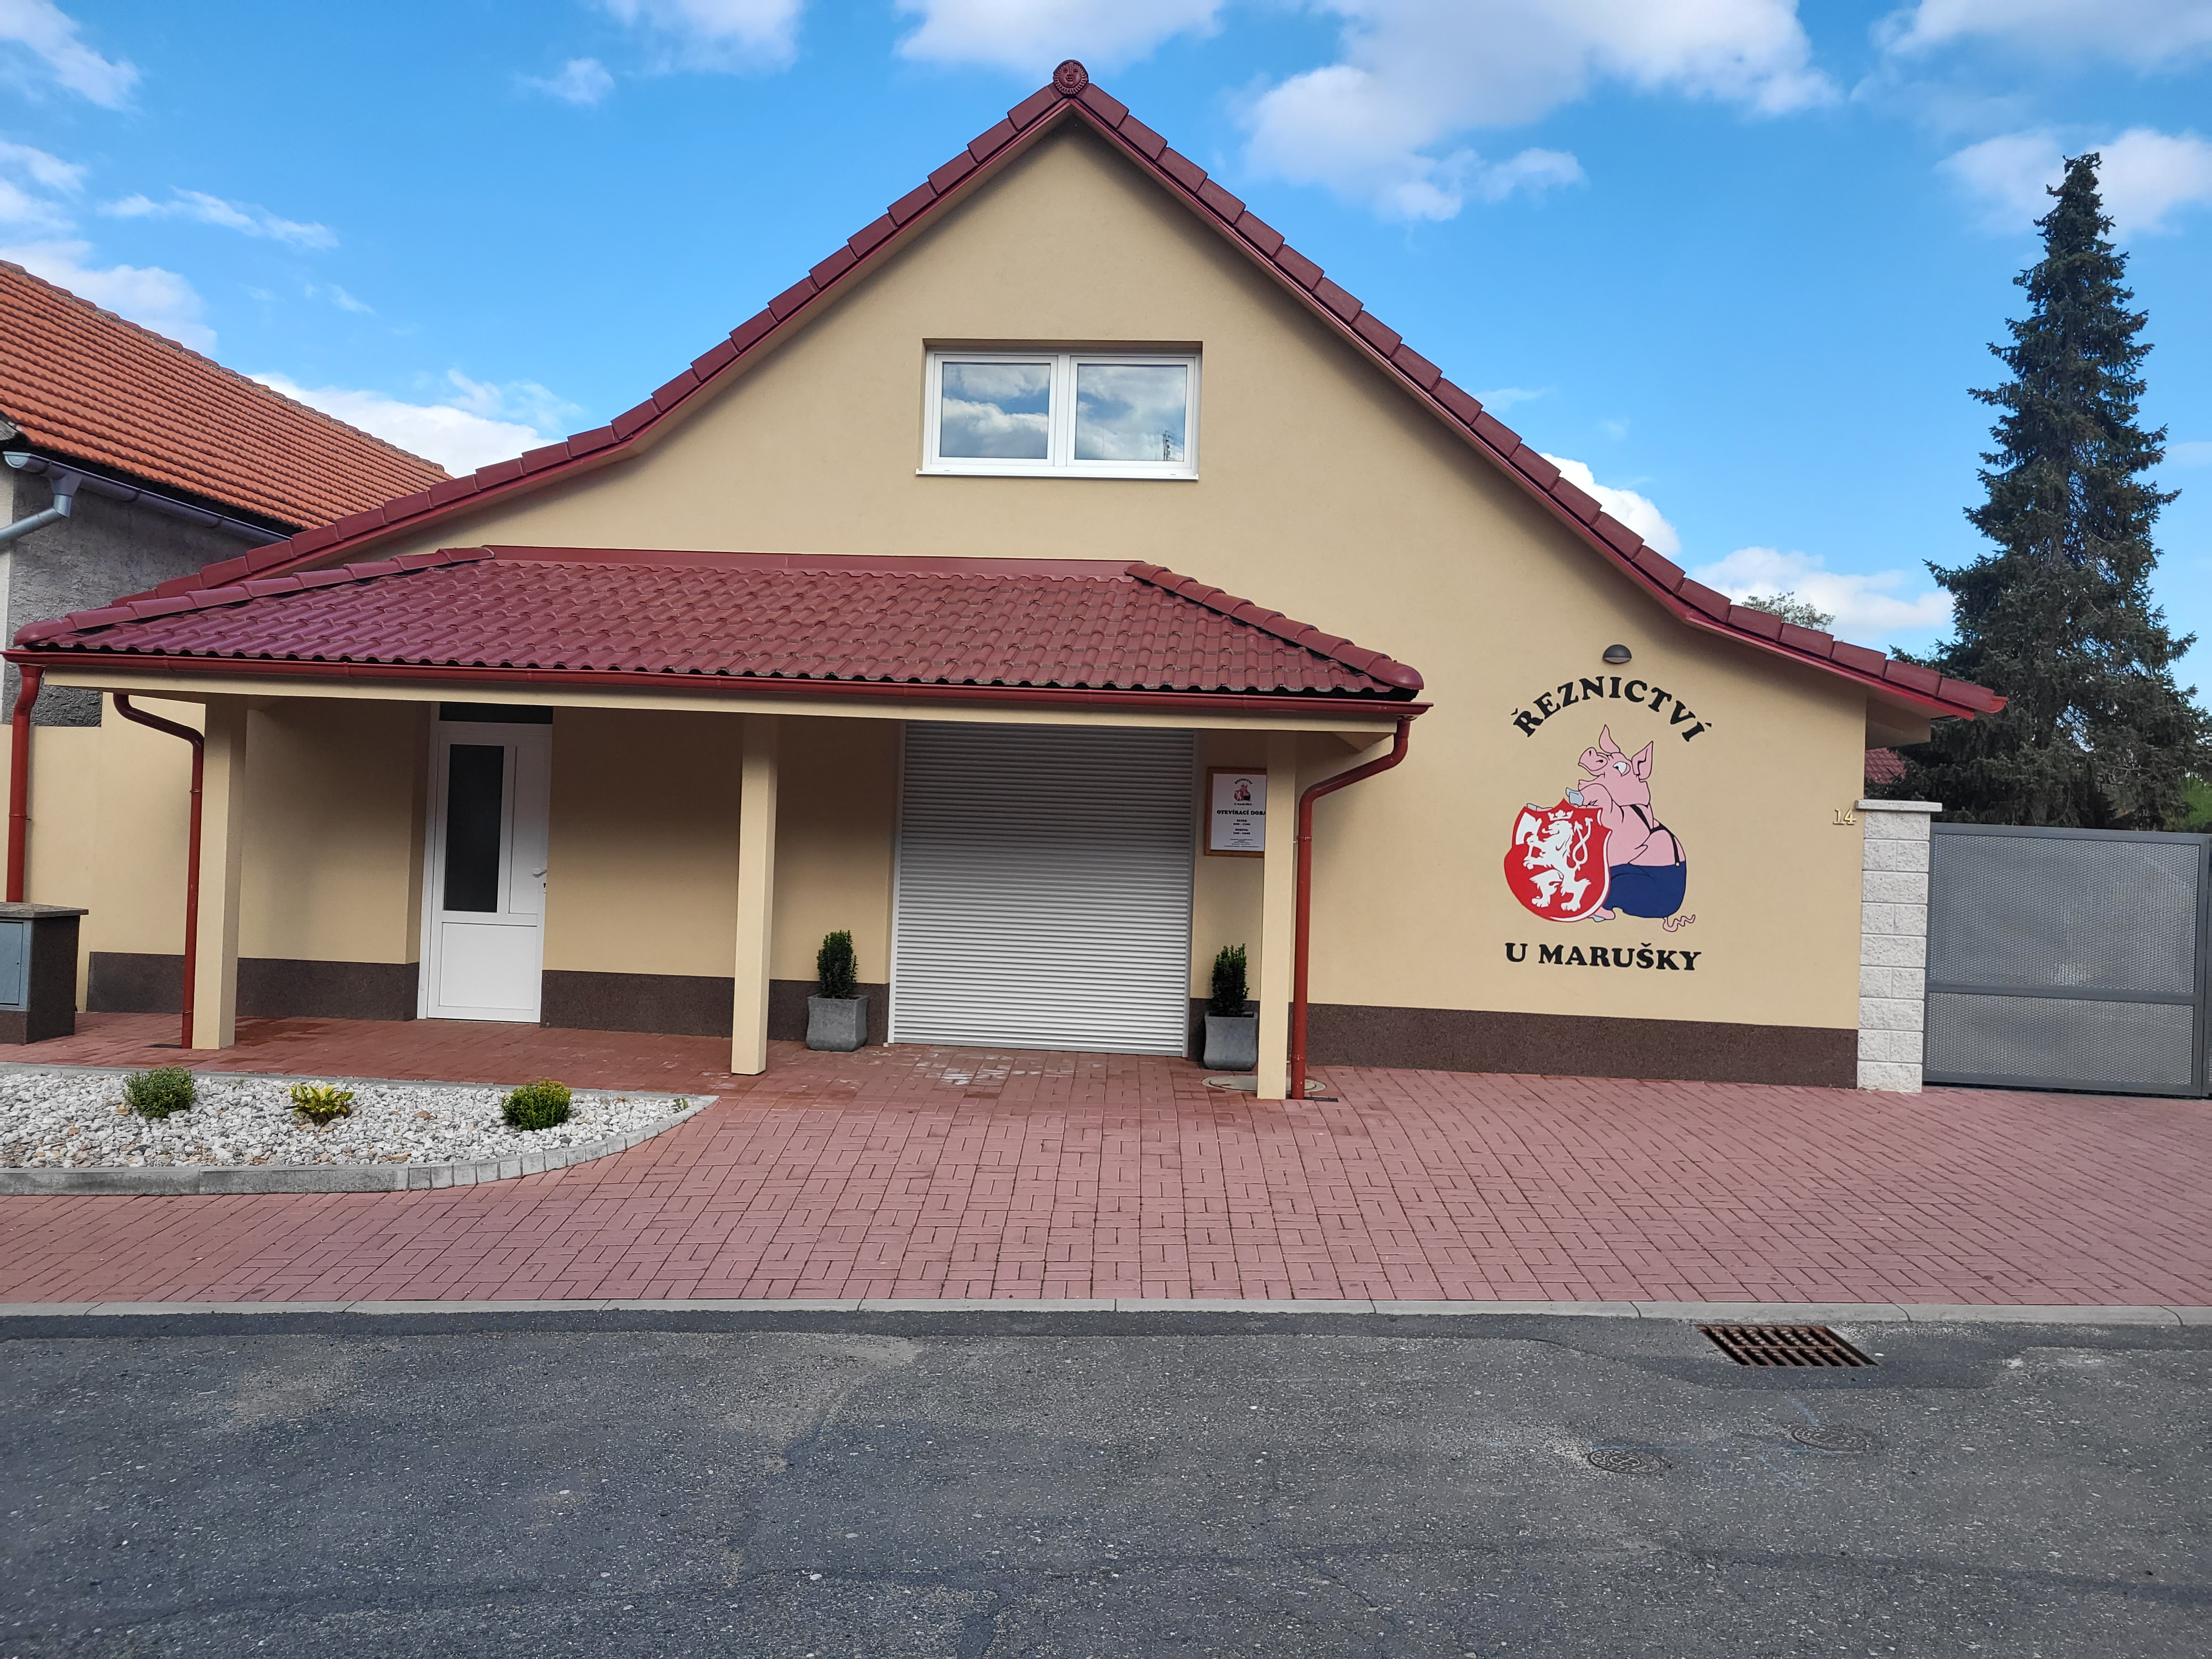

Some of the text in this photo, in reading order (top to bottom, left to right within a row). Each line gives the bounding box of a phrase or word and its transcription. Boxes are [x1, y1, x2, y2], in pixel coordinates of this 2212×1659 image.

[1510, 676, 1712, 742] ŘEZNICTVÍ
[1833, 807, 1858, 826] 14
[1505, 942, 1702, 971] U MARUŠKY
